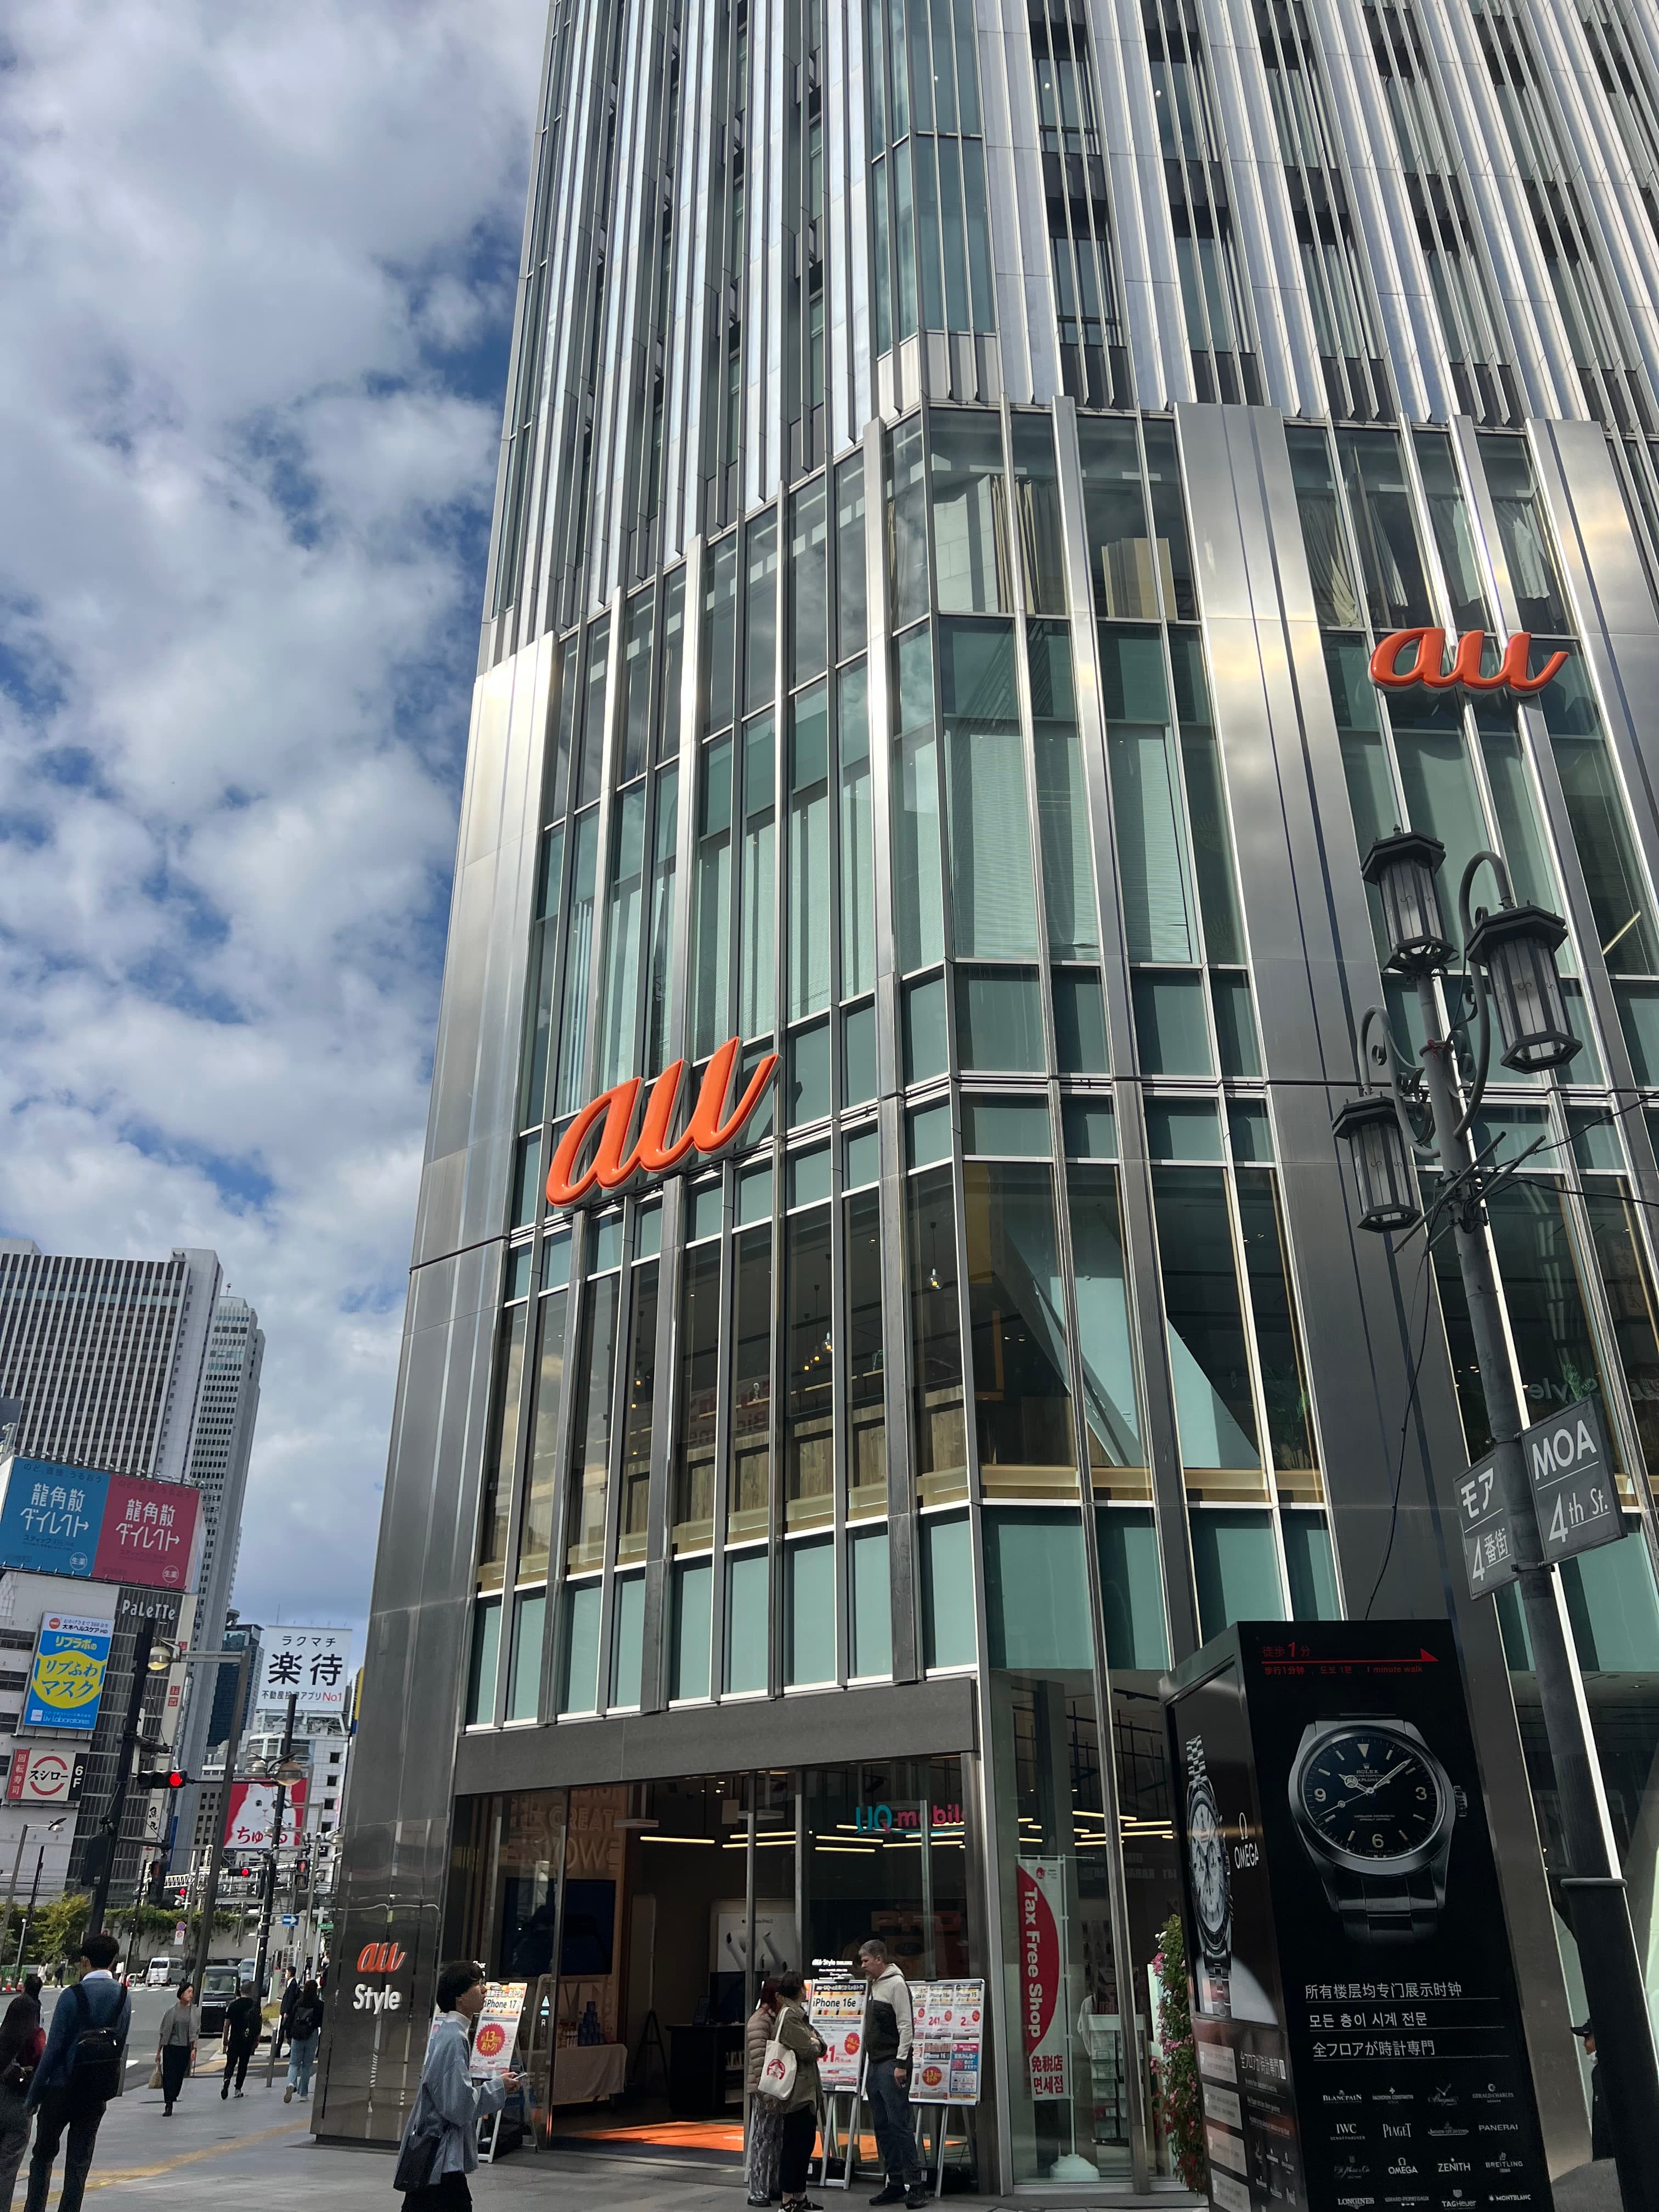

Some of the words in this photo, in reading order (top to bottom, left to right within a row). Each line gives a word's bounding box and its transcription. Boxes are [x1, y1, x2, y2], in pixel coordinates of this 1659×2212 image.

[1368, 627, 1570, 696] au
[546, 1036, 783, 1206] au
[1532, 1420, 1597, 1480] MOA
[31, 1482, 86, 1513] 龍角散
[1461, 1467, 1494, 1519] モア
[20, 1508, 89, 1538] ダイレクト
[125, 1498, 176, 1527] 龍角散
[1549, 1492, 1584, 1543] 4th
[1590, 1487, 1608, 1515] St.
[116, 1523, 180, 1552] ダイレクト
[1472, 1527, 1509, 1581] 4番街
[282, 1635, 336, 1647] ラクマチ
[268, 1651, 343, 1686] 楽待
[1403, 1665, 1423, 1673] walk
[42, 1680, 93, 1699] マスク
[12, 1753, 27, 1795] 回転寿司
[28, 1769, 69, 1781] スシロー
[1314, 1788, 1327, 1802] 9
[1415, 1786, 1428, 1801] 3
[855, 1804, 893, 1834] UQ
[898, 1804, 964, 1827] mbil
[1372, 1833, 1385, 1848] 6
[1234, 1841, 1260, 1870] OMEGA
[1024, 1887, 1037, 1926] Tax
[357, 1943, 407, 1973] au
[1026, 1931, 1040, 1977] Free
[353, 1983, 403, 2015] Style
[812, 1997, 840, 2007] iPhone
[843, 1998, 856, 2007] 16e
[1305, 1981, 1462, 2000] 所有楼层均专门展示时钟
[484, 1999, 507, 2009] iPhone
[509, 2000, 517, 2009] 17
[1028, 1983, 1043, 2038] Shop
[1309, 2013, 1335, 2028] 모든
[1340, 2012, 1366, 2028] 층이
[1372, 2011, 1398, 2028] 시계
[1402, 2011, 1427, 2027] 전문
[1312, 2039, 1435, 2058] 全フロアが時計専門
[1031, 2055, 1063, 2073] 免税店
[1034, 2075, 1064, 2096] 면세점
[1336, 2124, 1357, 2134] IWC
[1383, 2123, 1412, 2138] PIAGET
[1388, 2166, 1418, 2175] OMEGA
[1437, 2162, 1471, 2172] ZENITH
[1338, 2197, 1375, 2205] LONGINES
